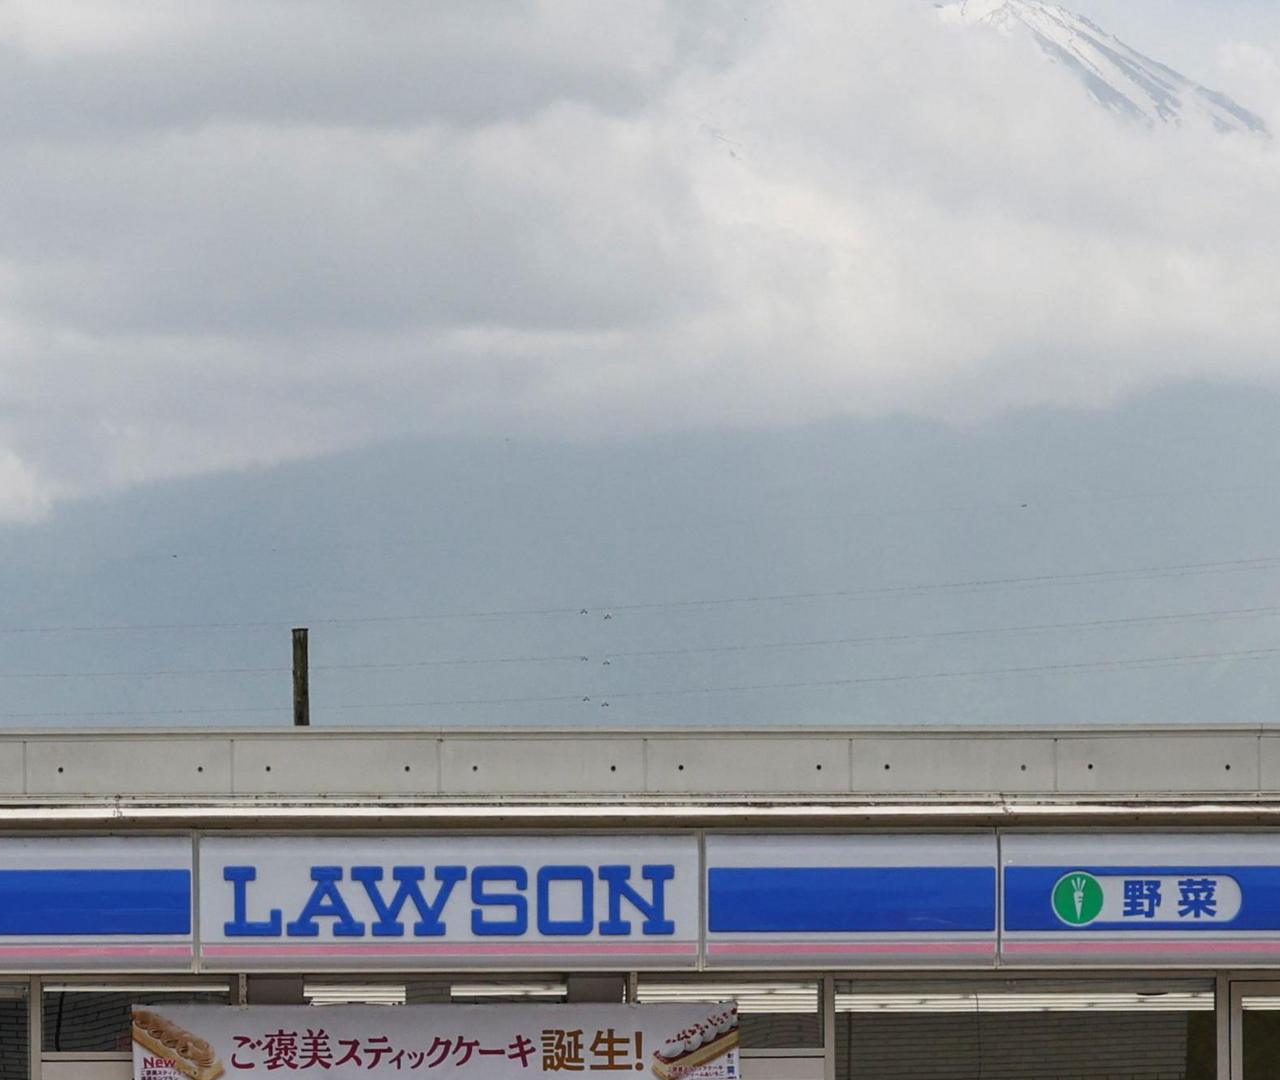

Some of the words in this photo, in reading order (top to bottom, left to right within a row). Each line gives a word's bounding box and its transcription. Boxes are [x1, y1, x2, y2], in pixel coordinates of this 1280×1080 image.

[224, 864, 675, 937] LAWSON
[1123, 877, 1218, 919] 野菜
[143, 1057, 176, 1068] New
